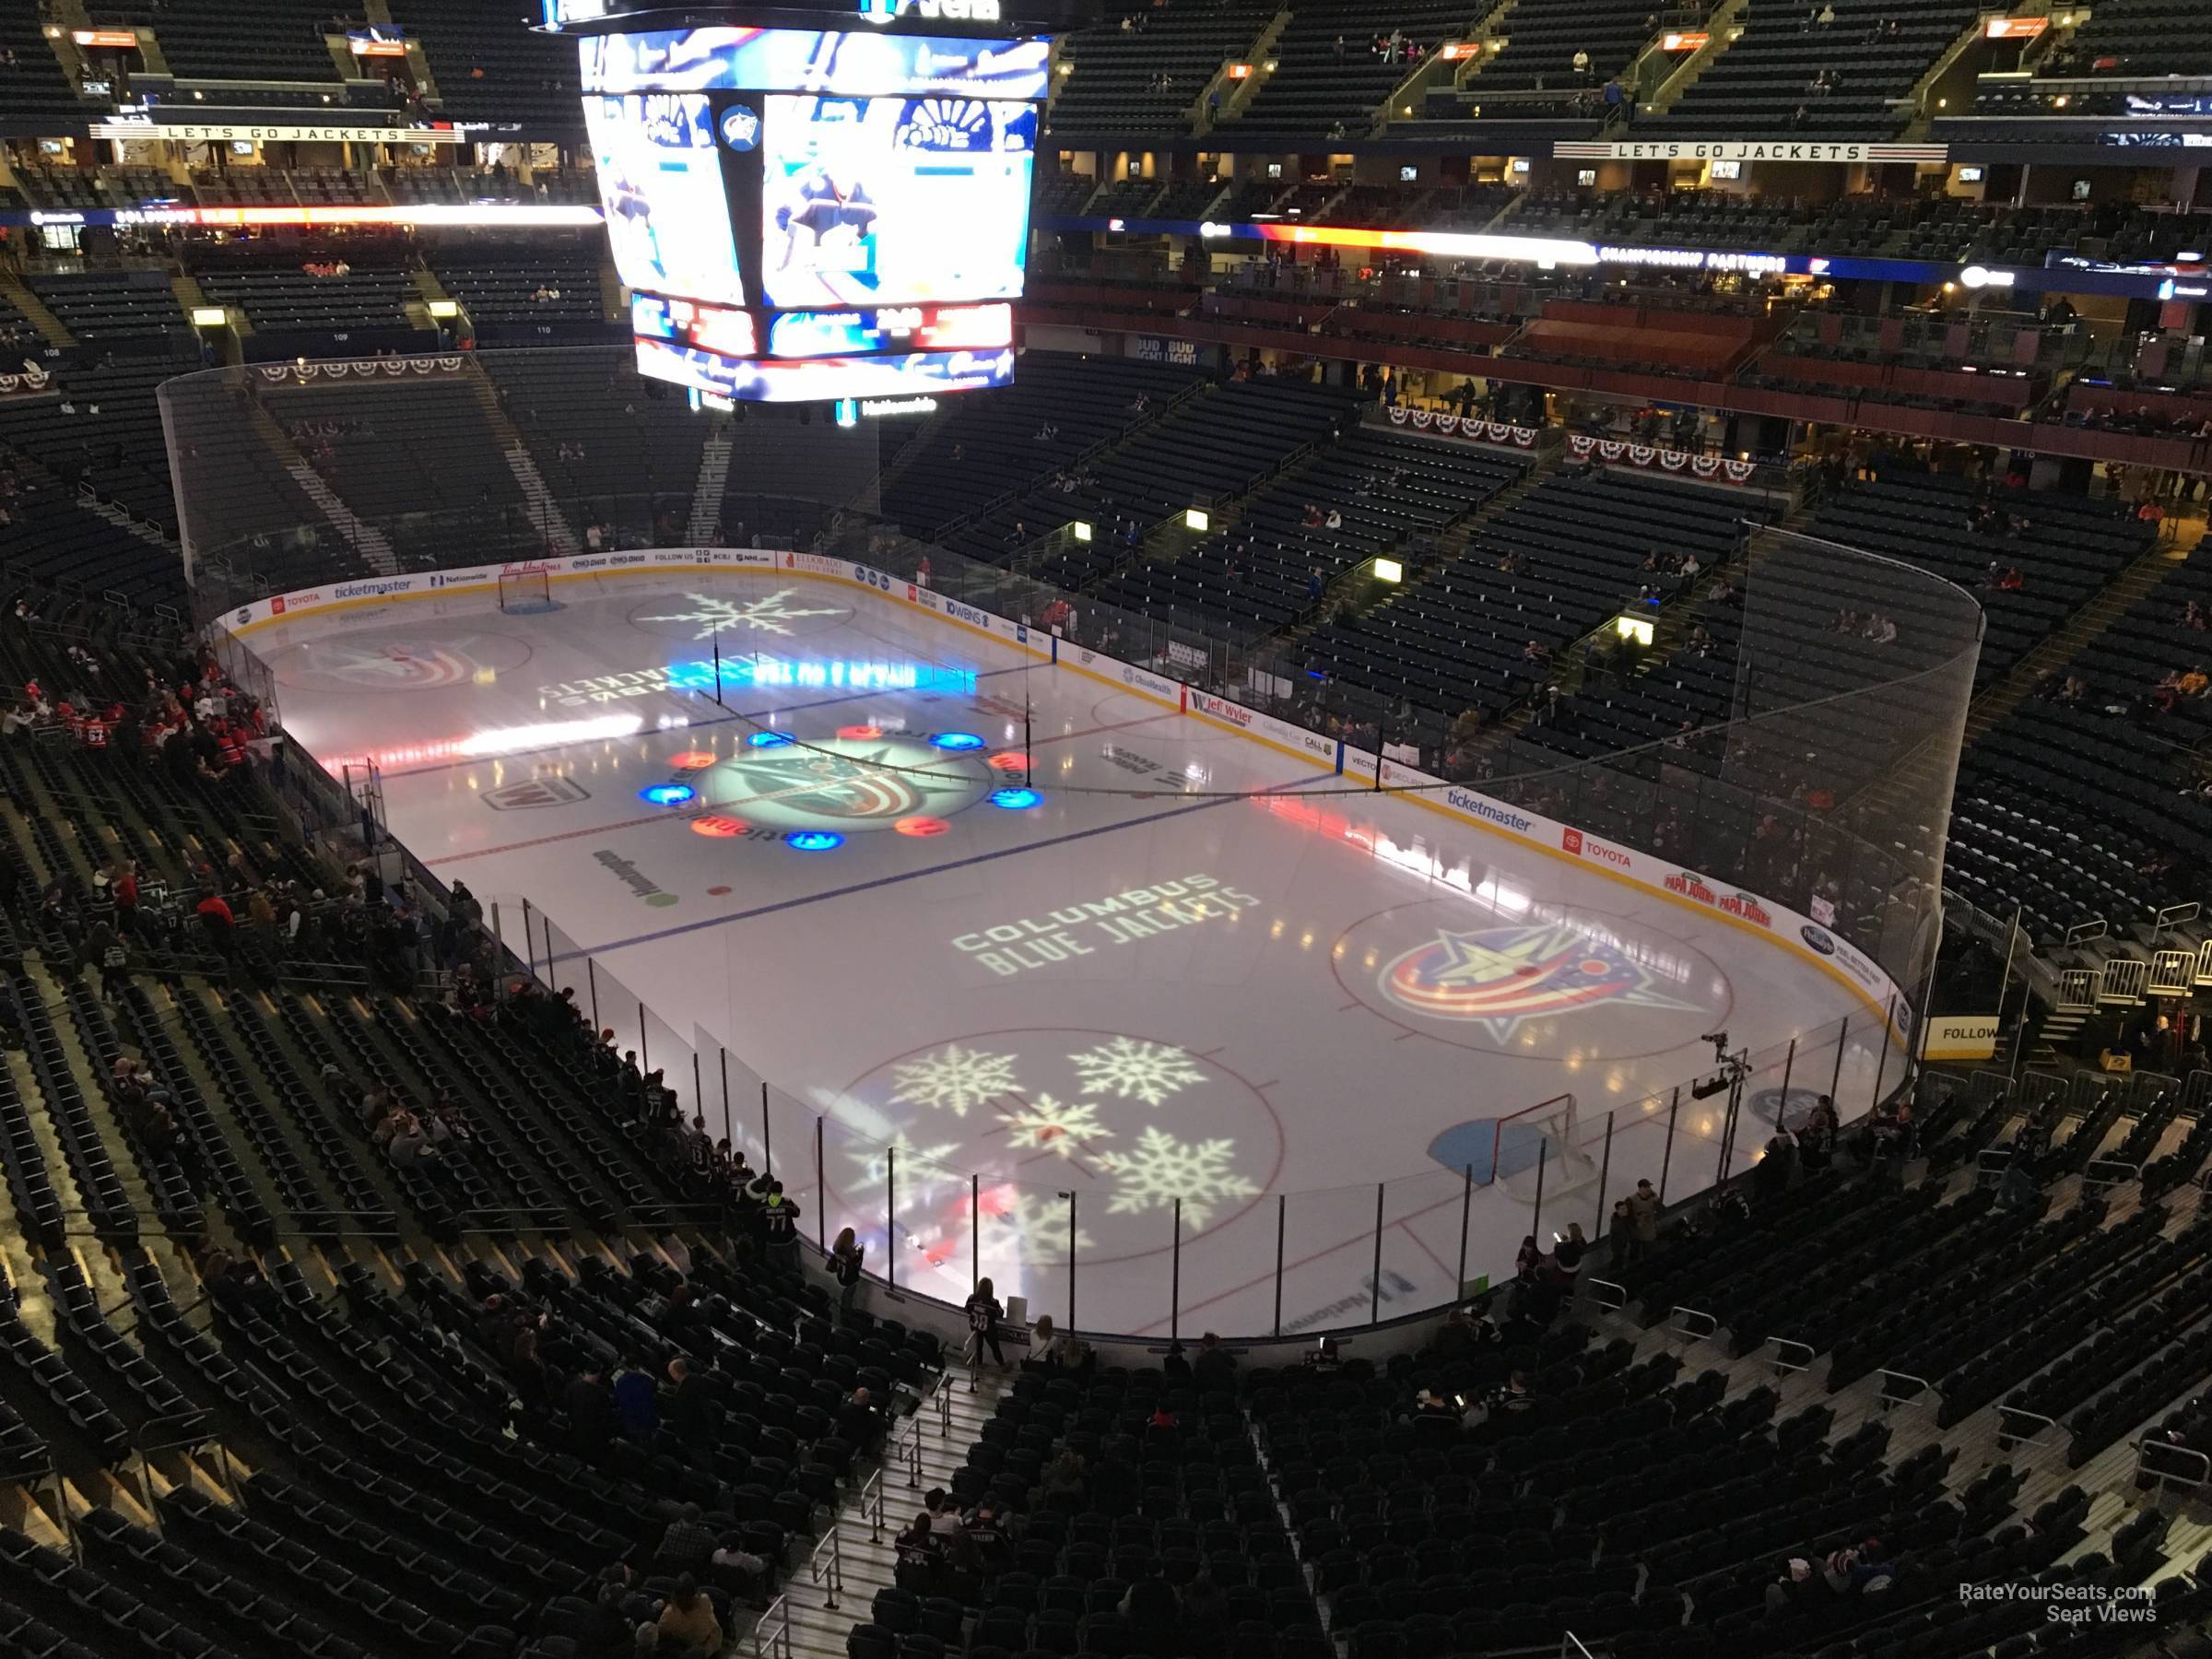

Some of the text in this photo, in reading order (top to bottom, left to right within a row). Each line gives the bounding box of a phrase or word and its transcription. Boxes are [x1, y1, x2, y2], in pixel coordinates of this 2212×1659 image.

[167, 127, 400, 140] LET'S GO JACKETS
[1618, 144, 1860, 159] LET'S GO JACKETS
[1600, 246, 1786, 273] CHAMPIONSHIP PARTNERS
[334, 333, 348, 342] 109
[537, 326, 551, 335] 110
[43, 348, 60, 358] 108
[1168, 340, 1195, 354] BUD
[1164, 352, 1197, 365] LIGHT
[445, 572, 488, 583] Nationwide
[334, 580, 411, 599] ticketmaster
[287, 593, 321, 606] TOYOTA
[1206, 698, 1224, 713] Jeff
[1224, 704, 1253, 724] Wyler
[1304, 736, 1323, 750] CALL
[1351, 757, 1378, 771] VECTO
[1447, 789, 1532, 832] ticketmaster
[1586, 841, 1631, 868] TOYOTA
[1664, 875, 1687, 893] PAPA
[1718, 896, 1742, 914] PAPA
[951, 874, 1219, 951] COLUMBUS
[973, 887, 1261, 977] BLUE JACKETS
[1943, 1028, 1998, 1040] FOLLOW
[766, 1215, 787, 1232] 77
